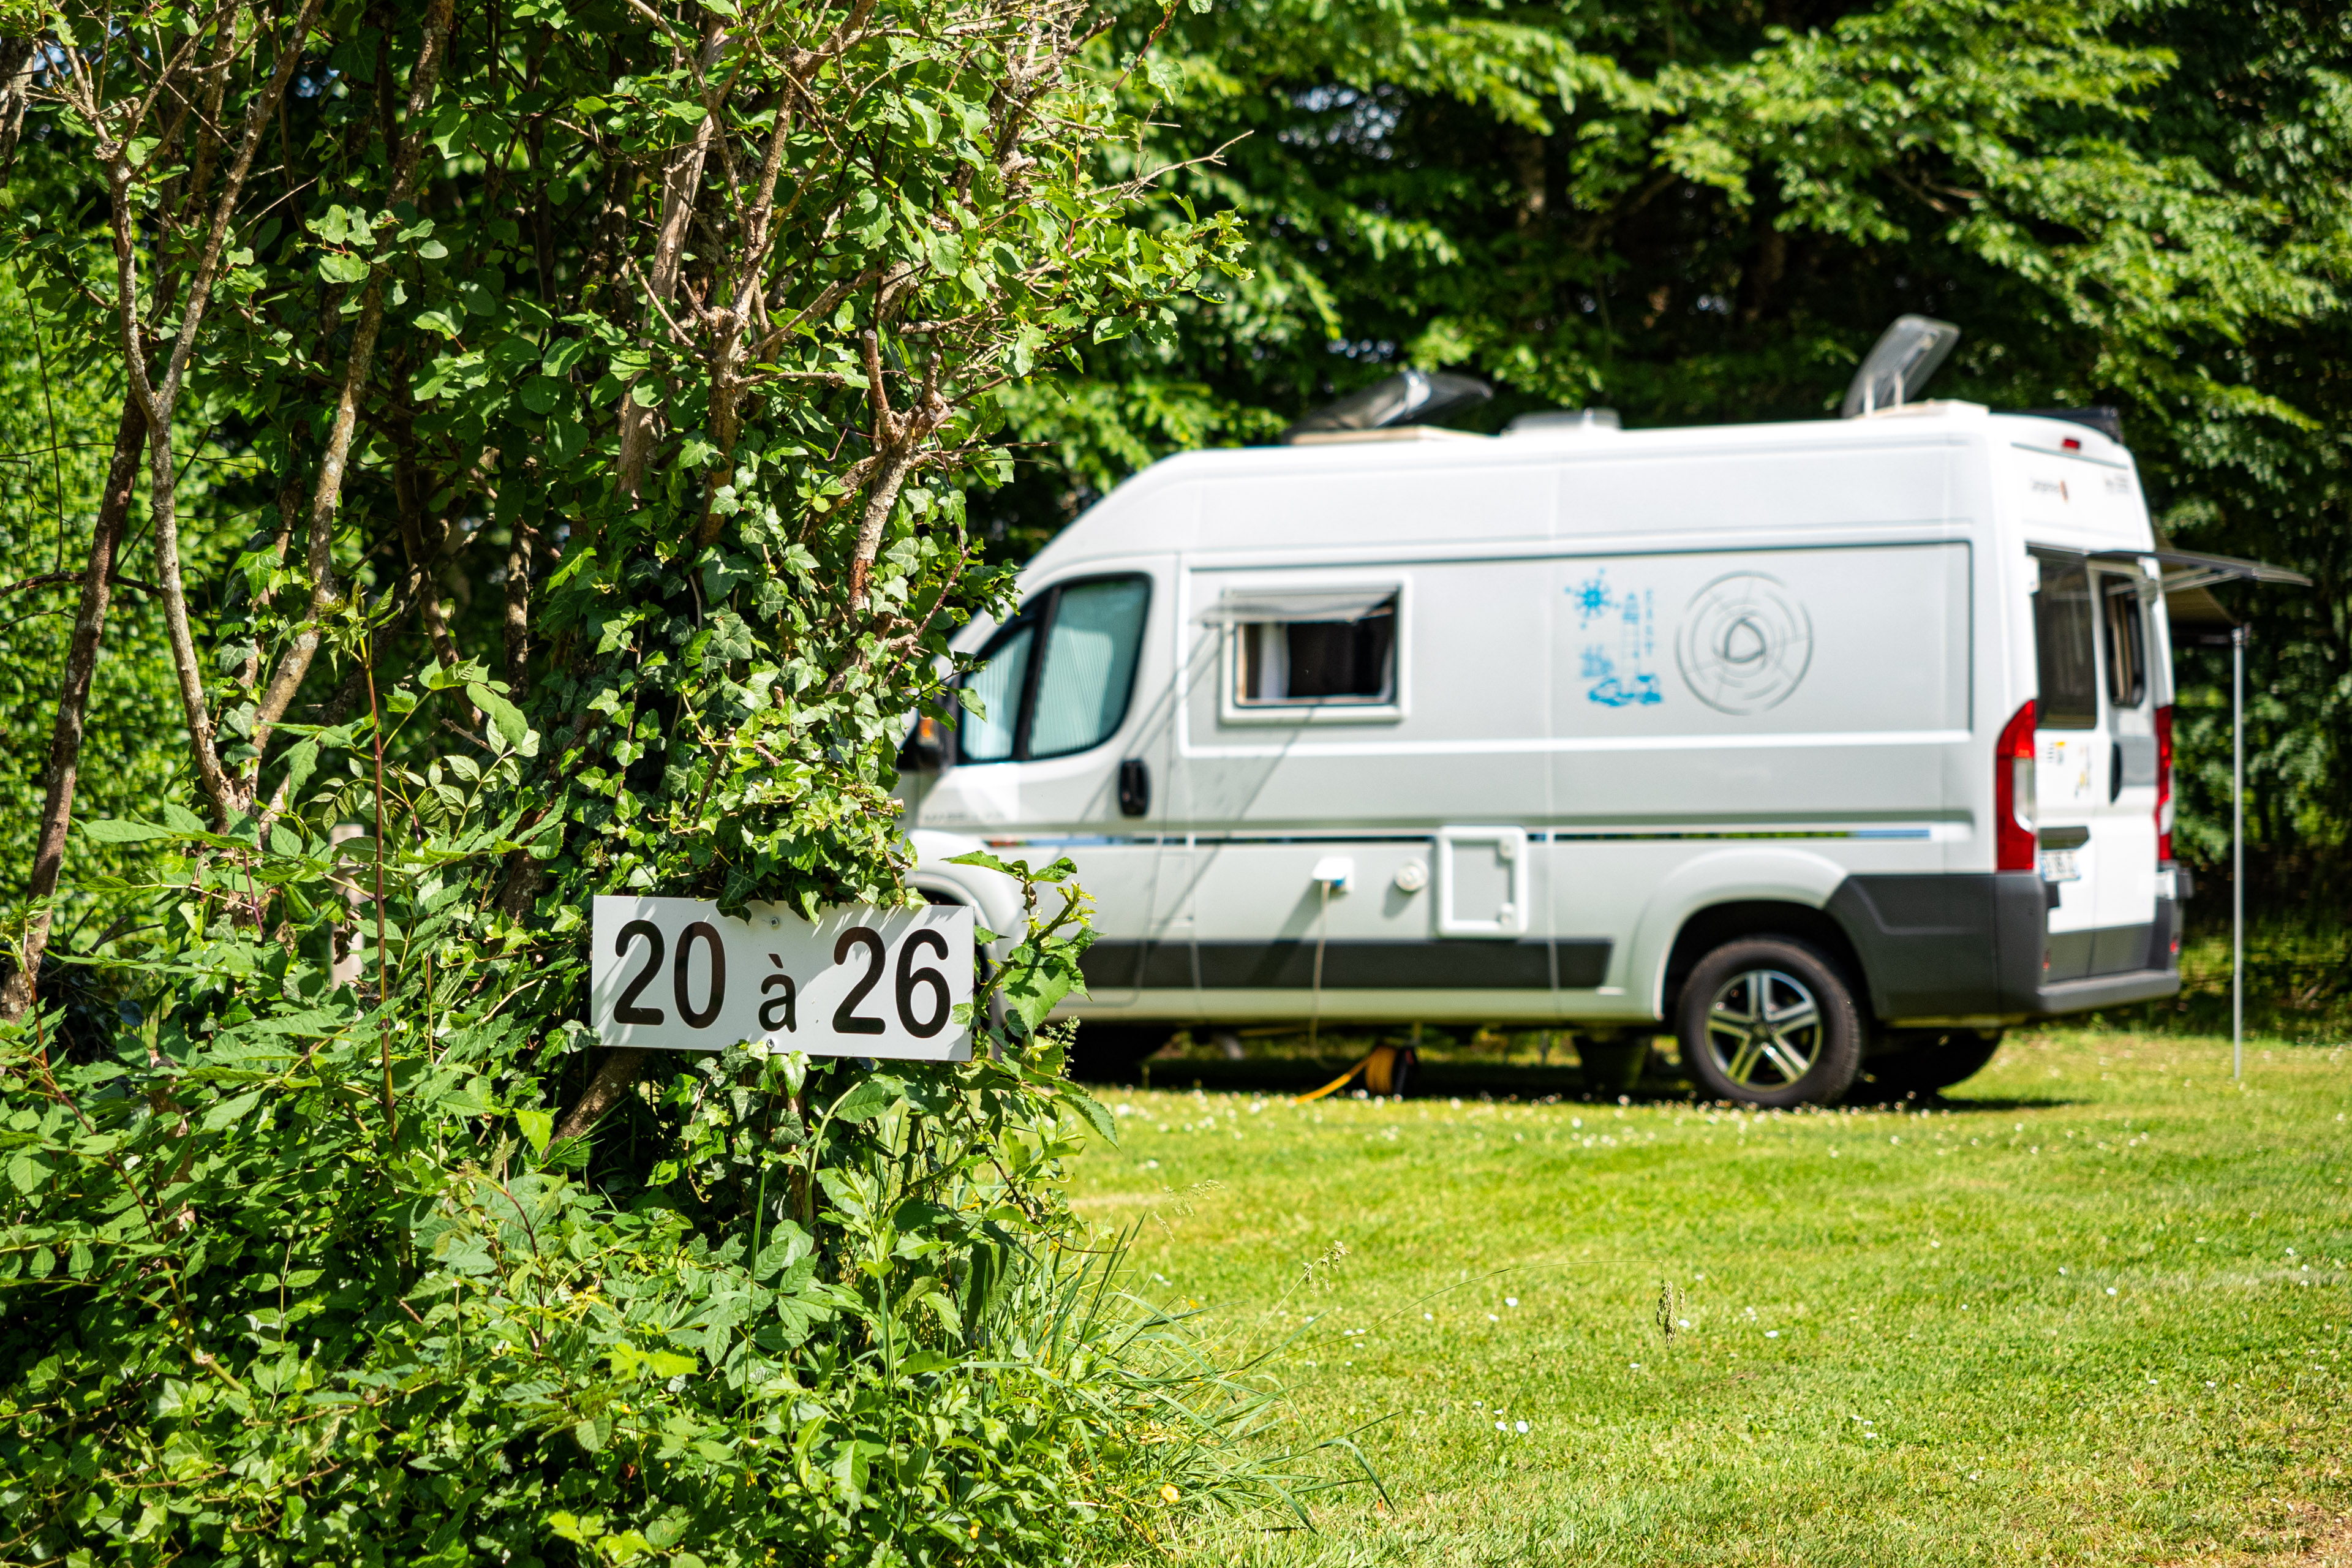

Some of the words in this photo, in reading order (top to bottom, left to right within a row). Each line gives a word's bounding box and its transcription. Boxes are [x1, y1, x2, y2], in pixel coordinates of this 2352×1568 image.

[613, 919, 726, 1029] 20
[758, 953, 797, 1033] à
[832, 926, 951, 1038] 26
